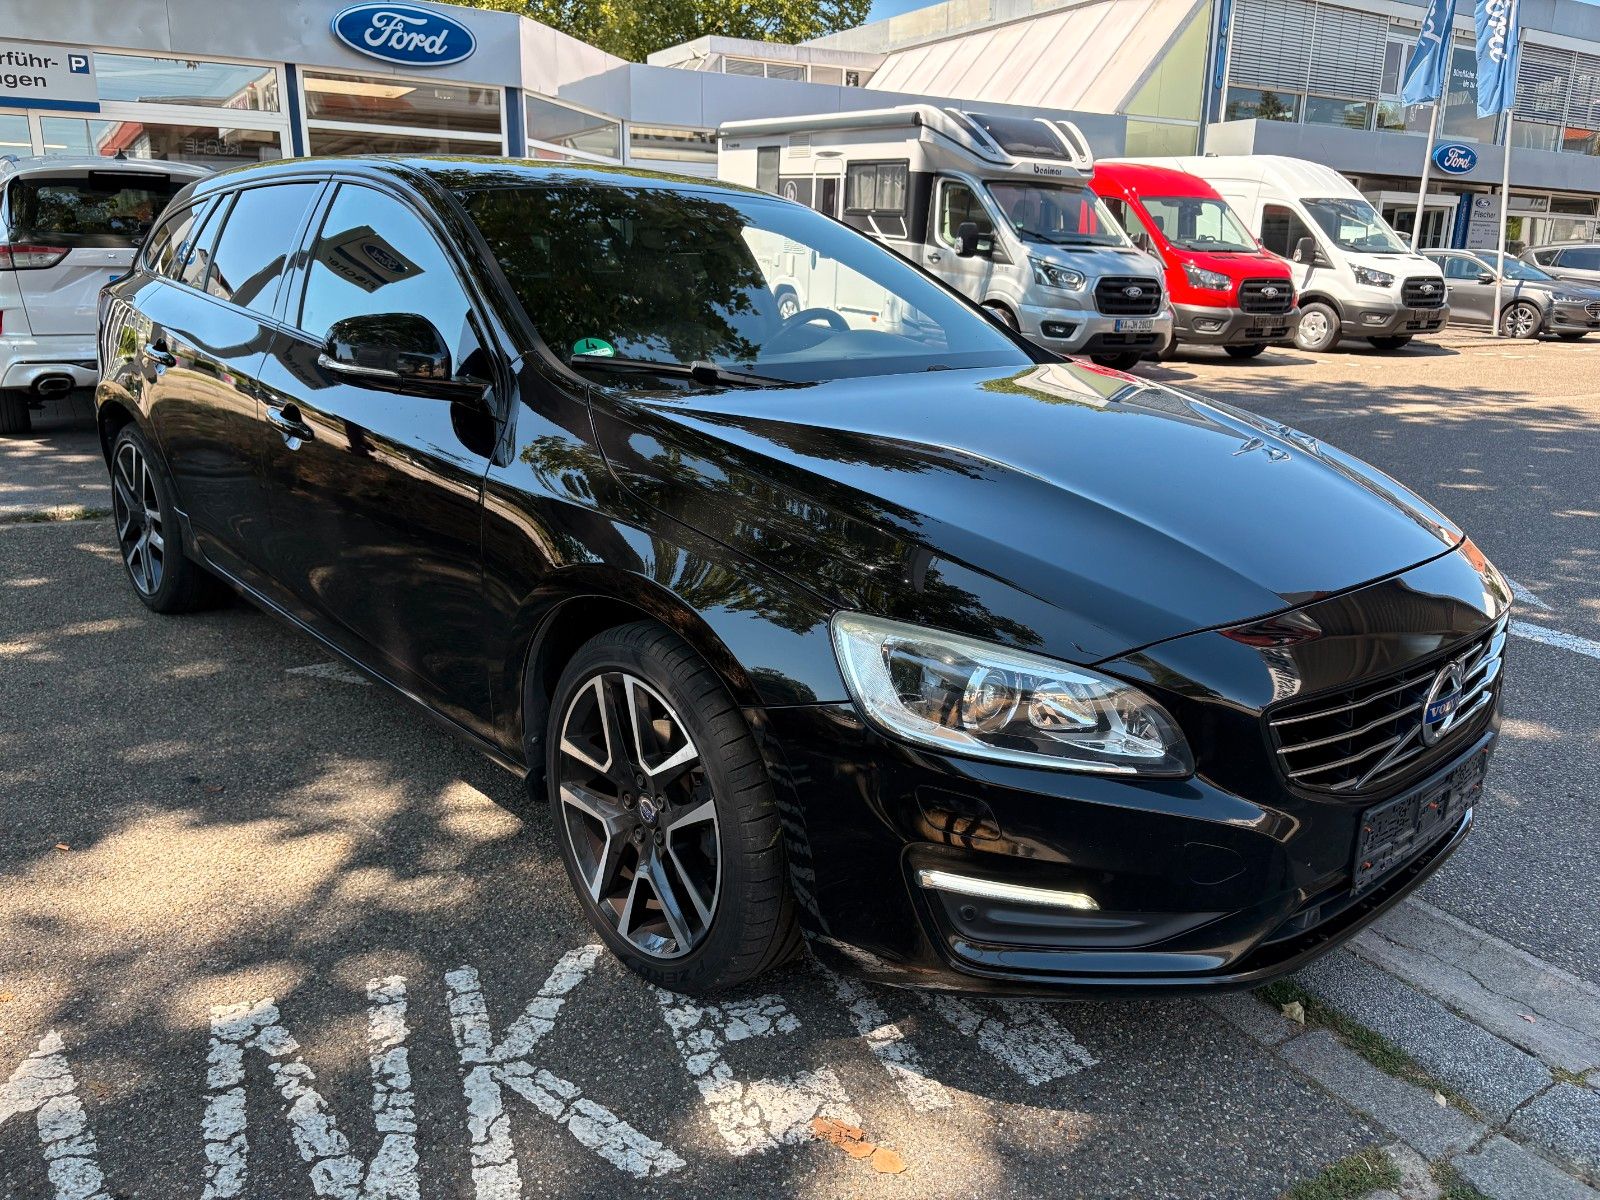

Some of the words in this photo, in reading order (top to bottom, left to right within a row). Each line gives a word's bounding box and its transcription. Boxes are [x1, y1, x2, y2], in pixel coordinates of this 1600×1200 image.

[364, 12, 448, 55] Ford
[71, 57, 86, 71] P
[0, 74, 47, 88] gen
[1444, 148, 1471, 168] Ford
